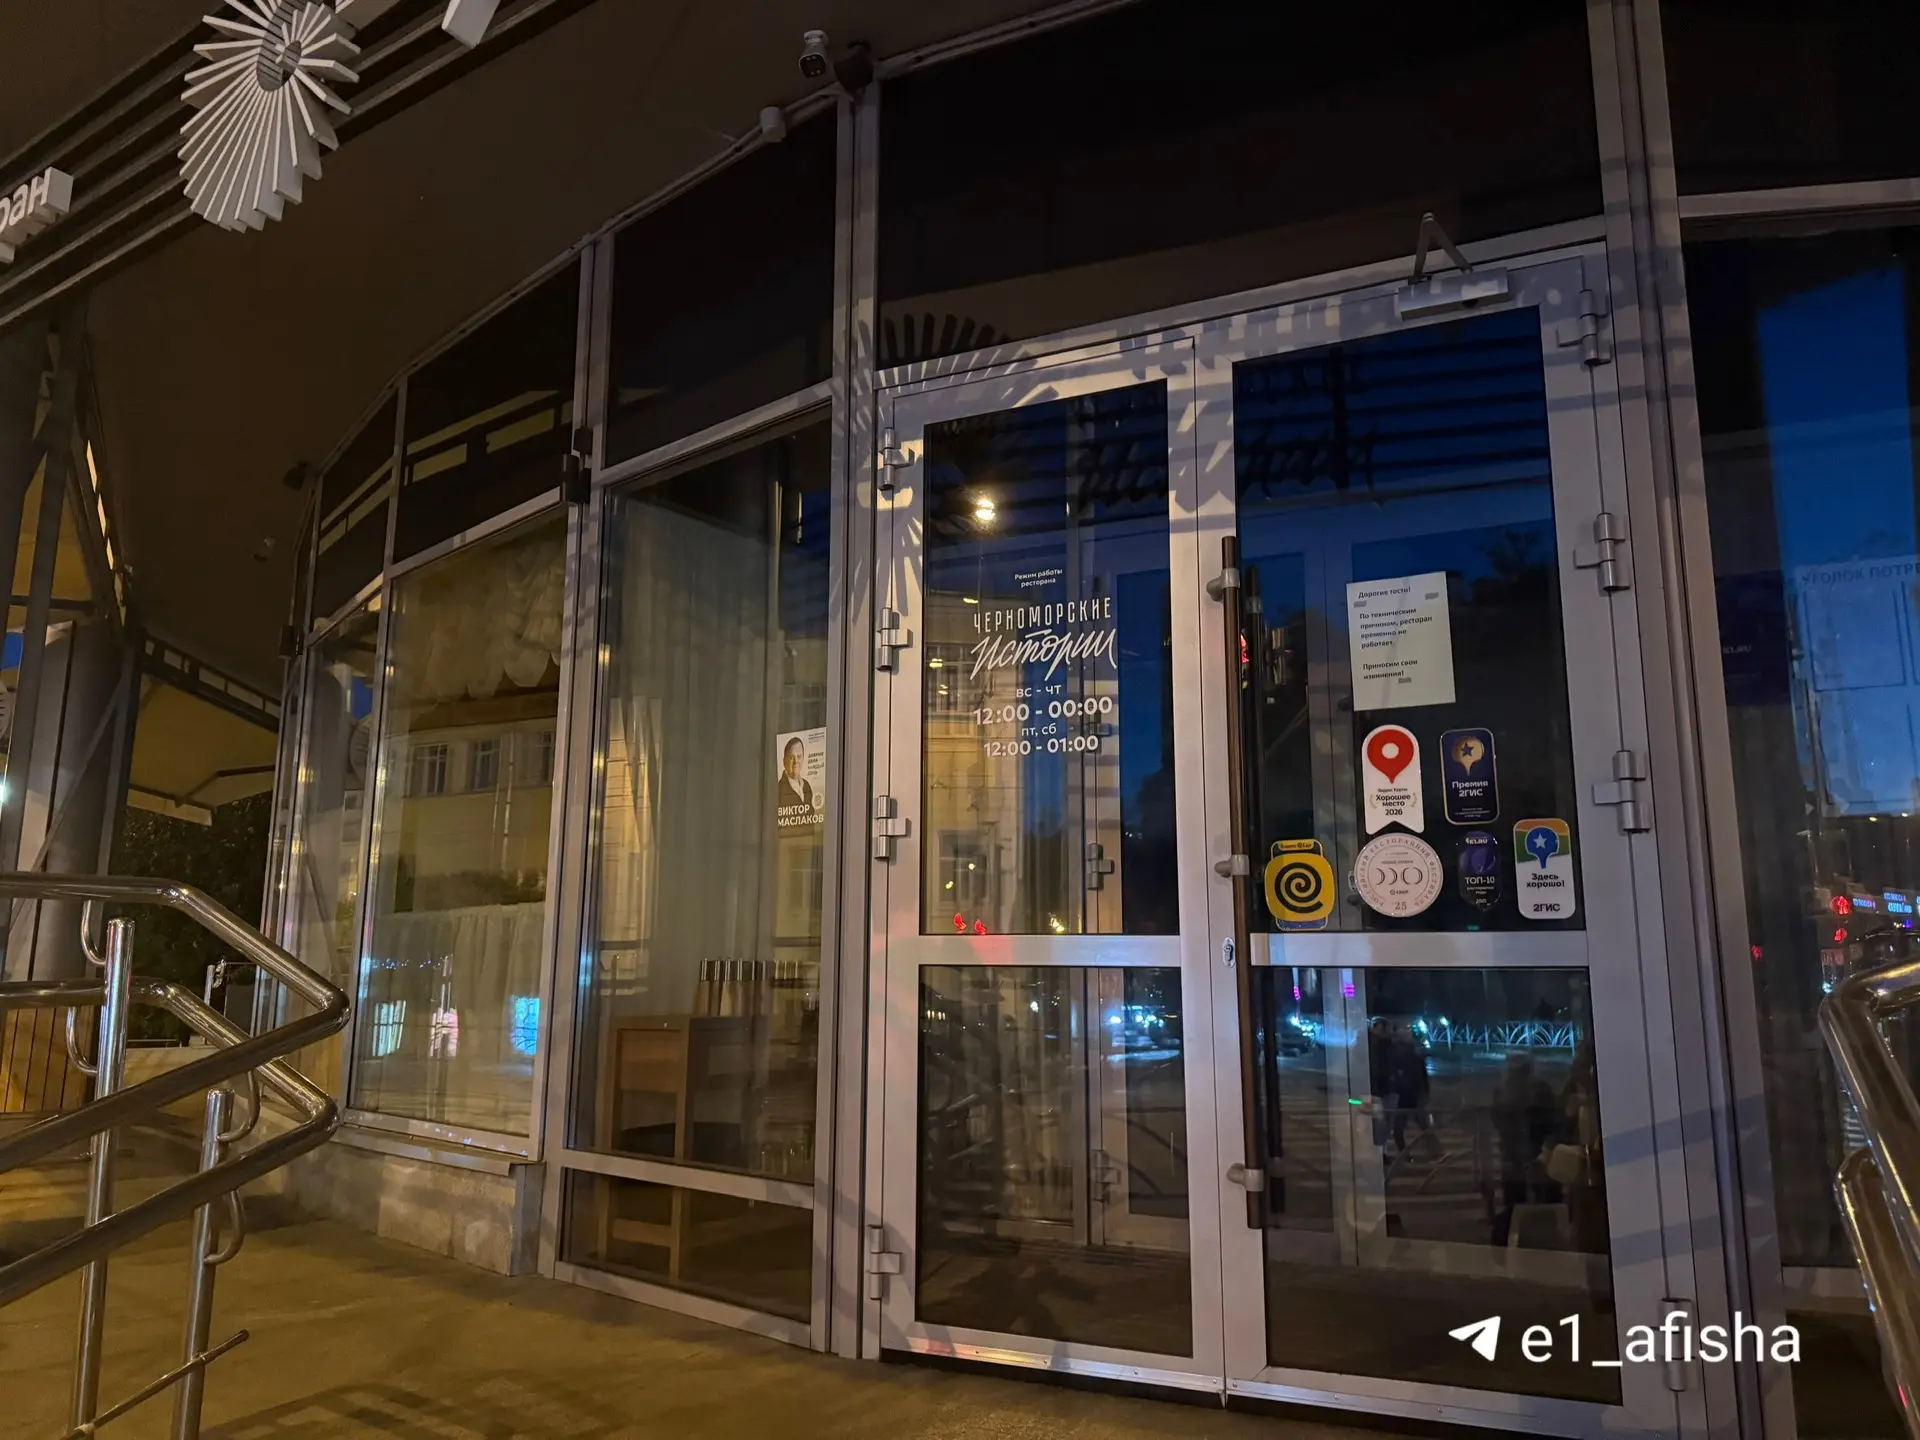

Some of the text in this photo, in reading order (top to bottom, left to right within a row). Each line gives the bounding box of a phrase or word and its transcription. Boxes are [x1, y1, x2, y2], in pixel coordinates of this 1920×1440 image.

[1014, 568, 1063, 580] Режим работы
[1020, 578, 1056, 588] ресторана
[1358, 586, 1411, 599] Дорогие гости!
[973, 597, 1112, 634] ЧЕРНОМОРСКИЕ
[1371, 608, 1417, 618] техническим
[1360, 616, 1433, 630] причинам, ресторан
[1360, 628, 1407, 640] временно не
[1362, 662, 1400, 671] Приносим
[1363, 670, 1404, 680] извинения!
[973, 704, 1030, 726] 12:00
[1048, 696, 1113, 718] 00:00
[1042, 722, 1056, 736] сб
[984, 740, 1031, 758] 12:00
[1047, 735, 1099, 753] 01:00
[1452, 780, 1488, 790] Премия
[1376, 794, 1410, 802] Хорошее
[1459, 789, 1483, 797] 2ГИС
[778, 804, 810, 816] ВИКТОР
[1385, 808, 1403, 816] 2026
[778, 814, 824, 826] МАСЛАКОВ
[1464, 876, 1495, 884] ТОП-10
[1532, 873, 1559, 882] Здесь
[1526, 880, 1565, 888] хорошо!
[1533, 904, 1560, 912] 2ГИС
